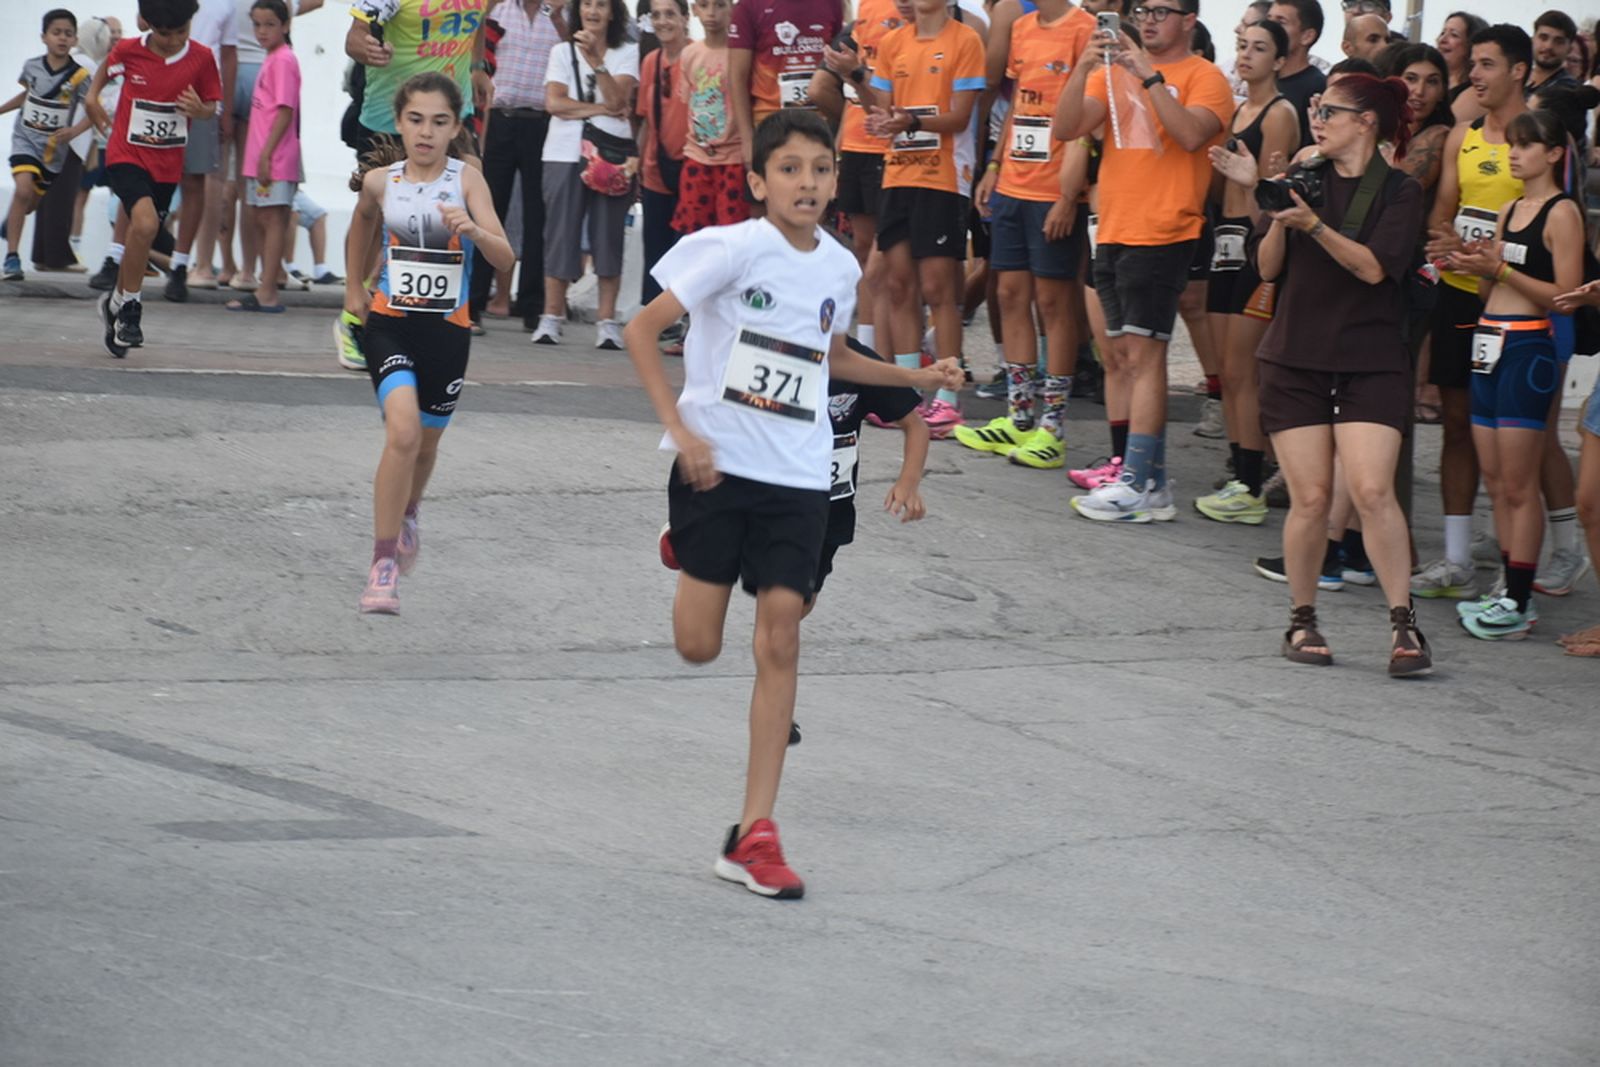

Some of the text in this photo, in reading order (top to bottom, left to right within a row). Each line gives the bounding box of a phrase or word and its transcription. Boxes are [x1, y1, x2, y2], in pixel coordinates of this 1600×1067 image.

[1020, 88, 1043, 106] TRI
[31, 110, 58, 126] 324
[143, 119, 177, 138] 382
[1016, 134, 1035, 151] 19
[398, 272, 449, 298] 309
[747, 364, 803, 405] 371
